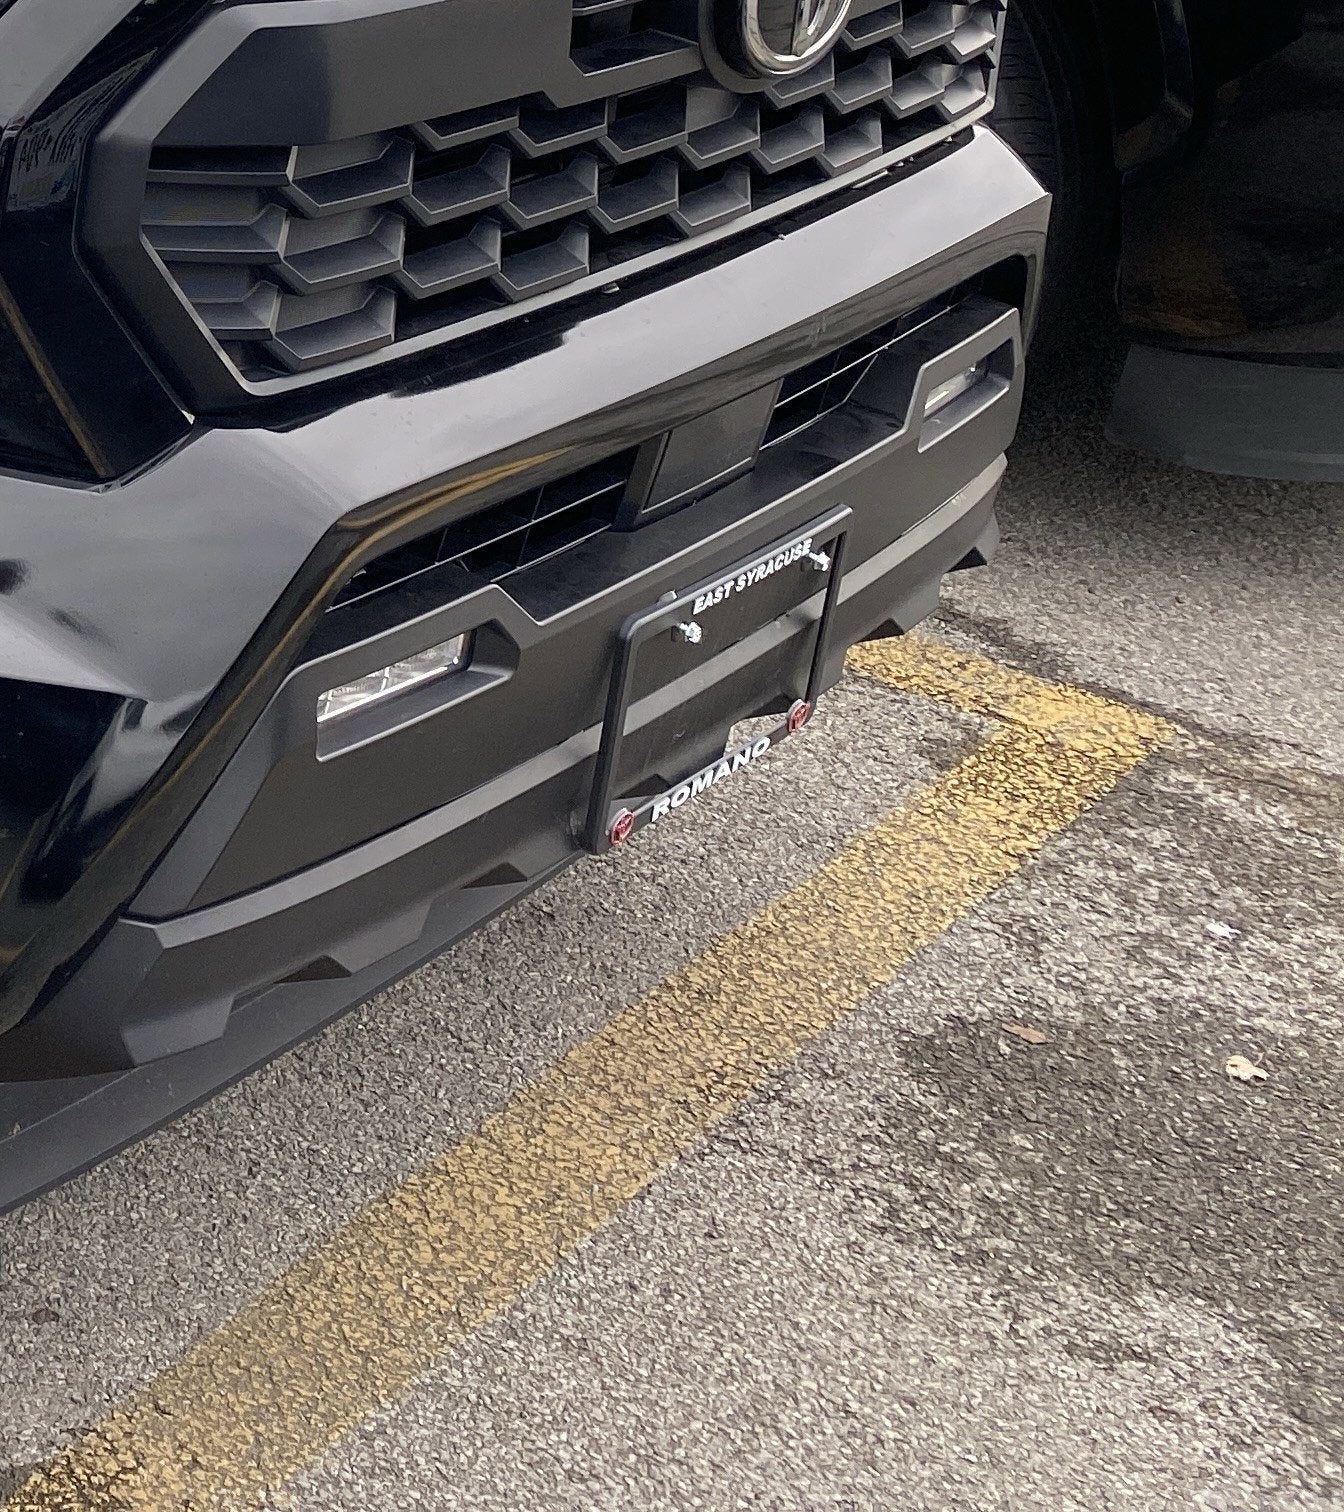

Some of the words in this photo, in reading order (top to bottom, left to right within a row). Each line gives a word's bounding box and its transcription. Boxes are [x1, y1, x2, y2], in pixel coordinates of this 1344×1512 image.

[692, 584, 734, 615] EAST
[735, 539, 813, 593] SYRACUSE
[651, 737, 771, 823] ROMANO
